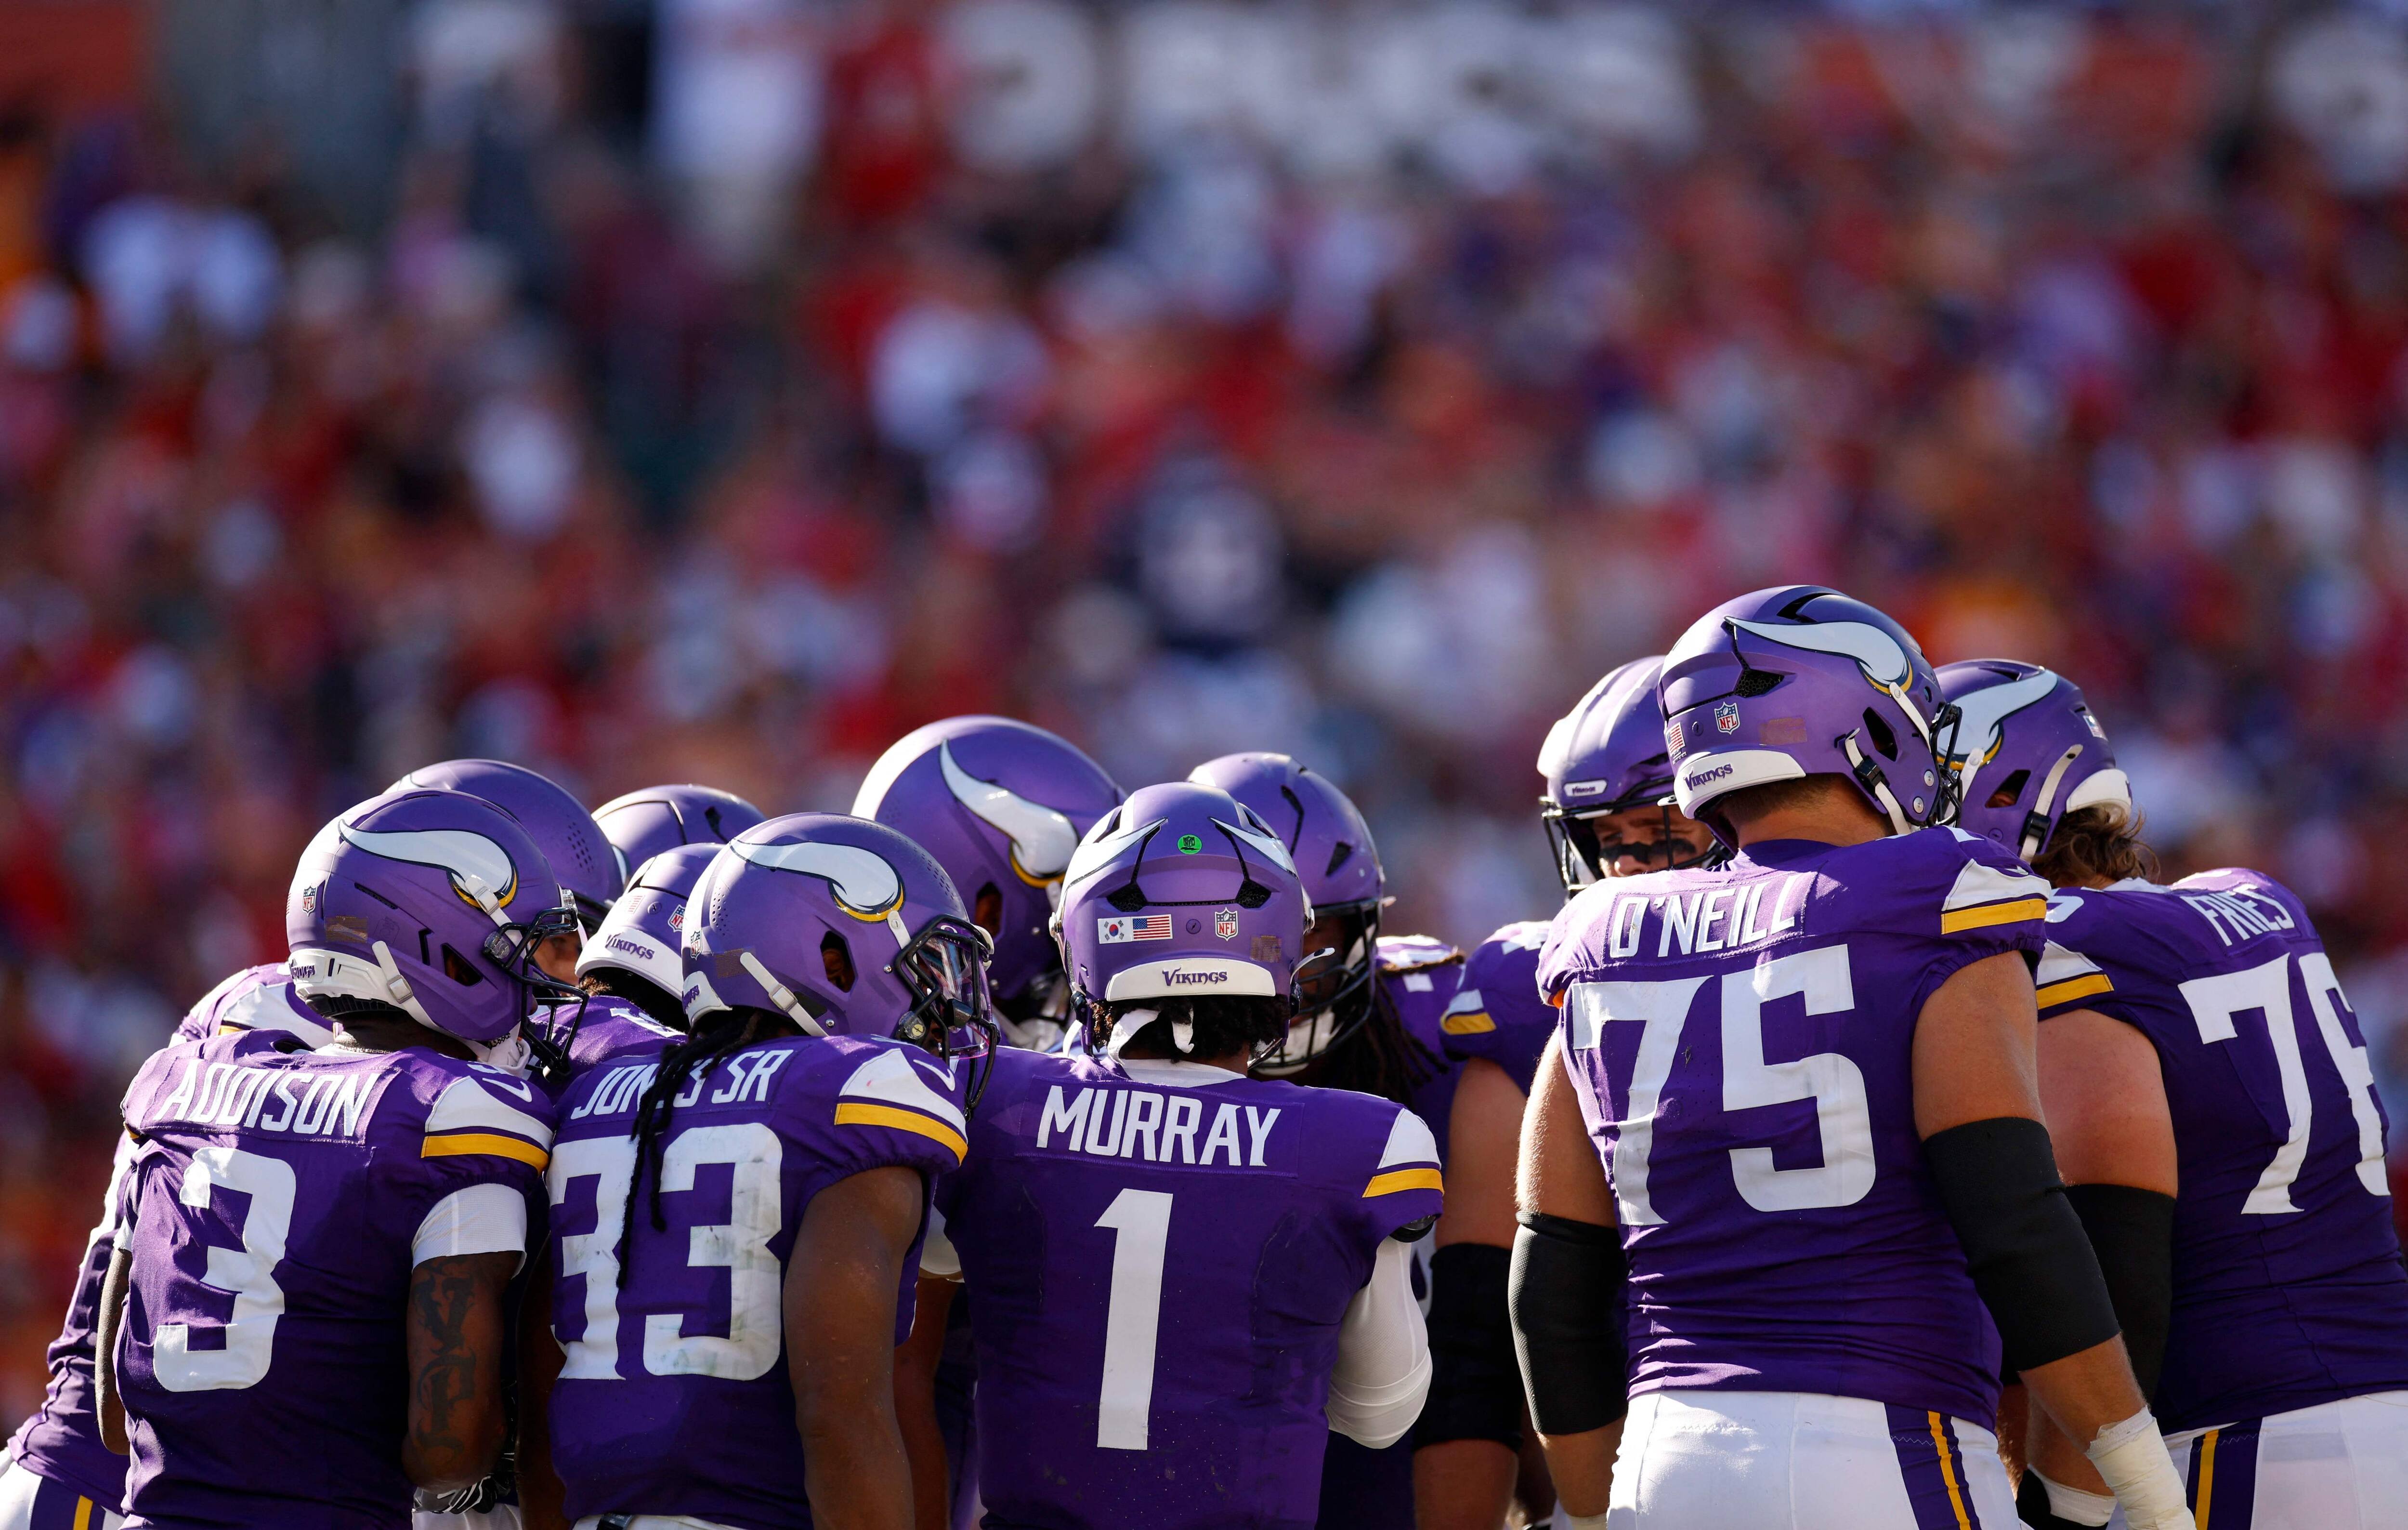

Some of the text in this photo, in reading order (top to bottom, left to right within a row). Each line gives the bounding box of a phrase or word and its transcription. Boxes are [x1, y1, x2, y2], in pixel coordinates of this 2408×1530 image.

[1719, 715, 1737, 729] NFL
[1684, 764, 1733, 791] VIKINGS
[303, 897, 314, 909] NFL
[671, 914, 683, 928] NF
[1218, 922, 1235, 935] NFL
[1610, 871, 1798, 959] O'NEILL
[2180, 884, 2295, 947] FRIES
[605, 933, 655, 960] VIKINGS
[1162, 967, 1228, 986] VIKINGS
[153, 1056, 381, 1137] ADDISON
[570, 1049, 794, 1120] JONS SR
[1573, 944, 1876, 1226] 75
[2178, 952, 2390, 1213] 76
[1036, 1085, 1281, 1167] MURRAY
[153, 1147, 296, 1392] 3
[546, 1122, 783, 1381] 33
[1094, 1188, 1174, 1451] 1
